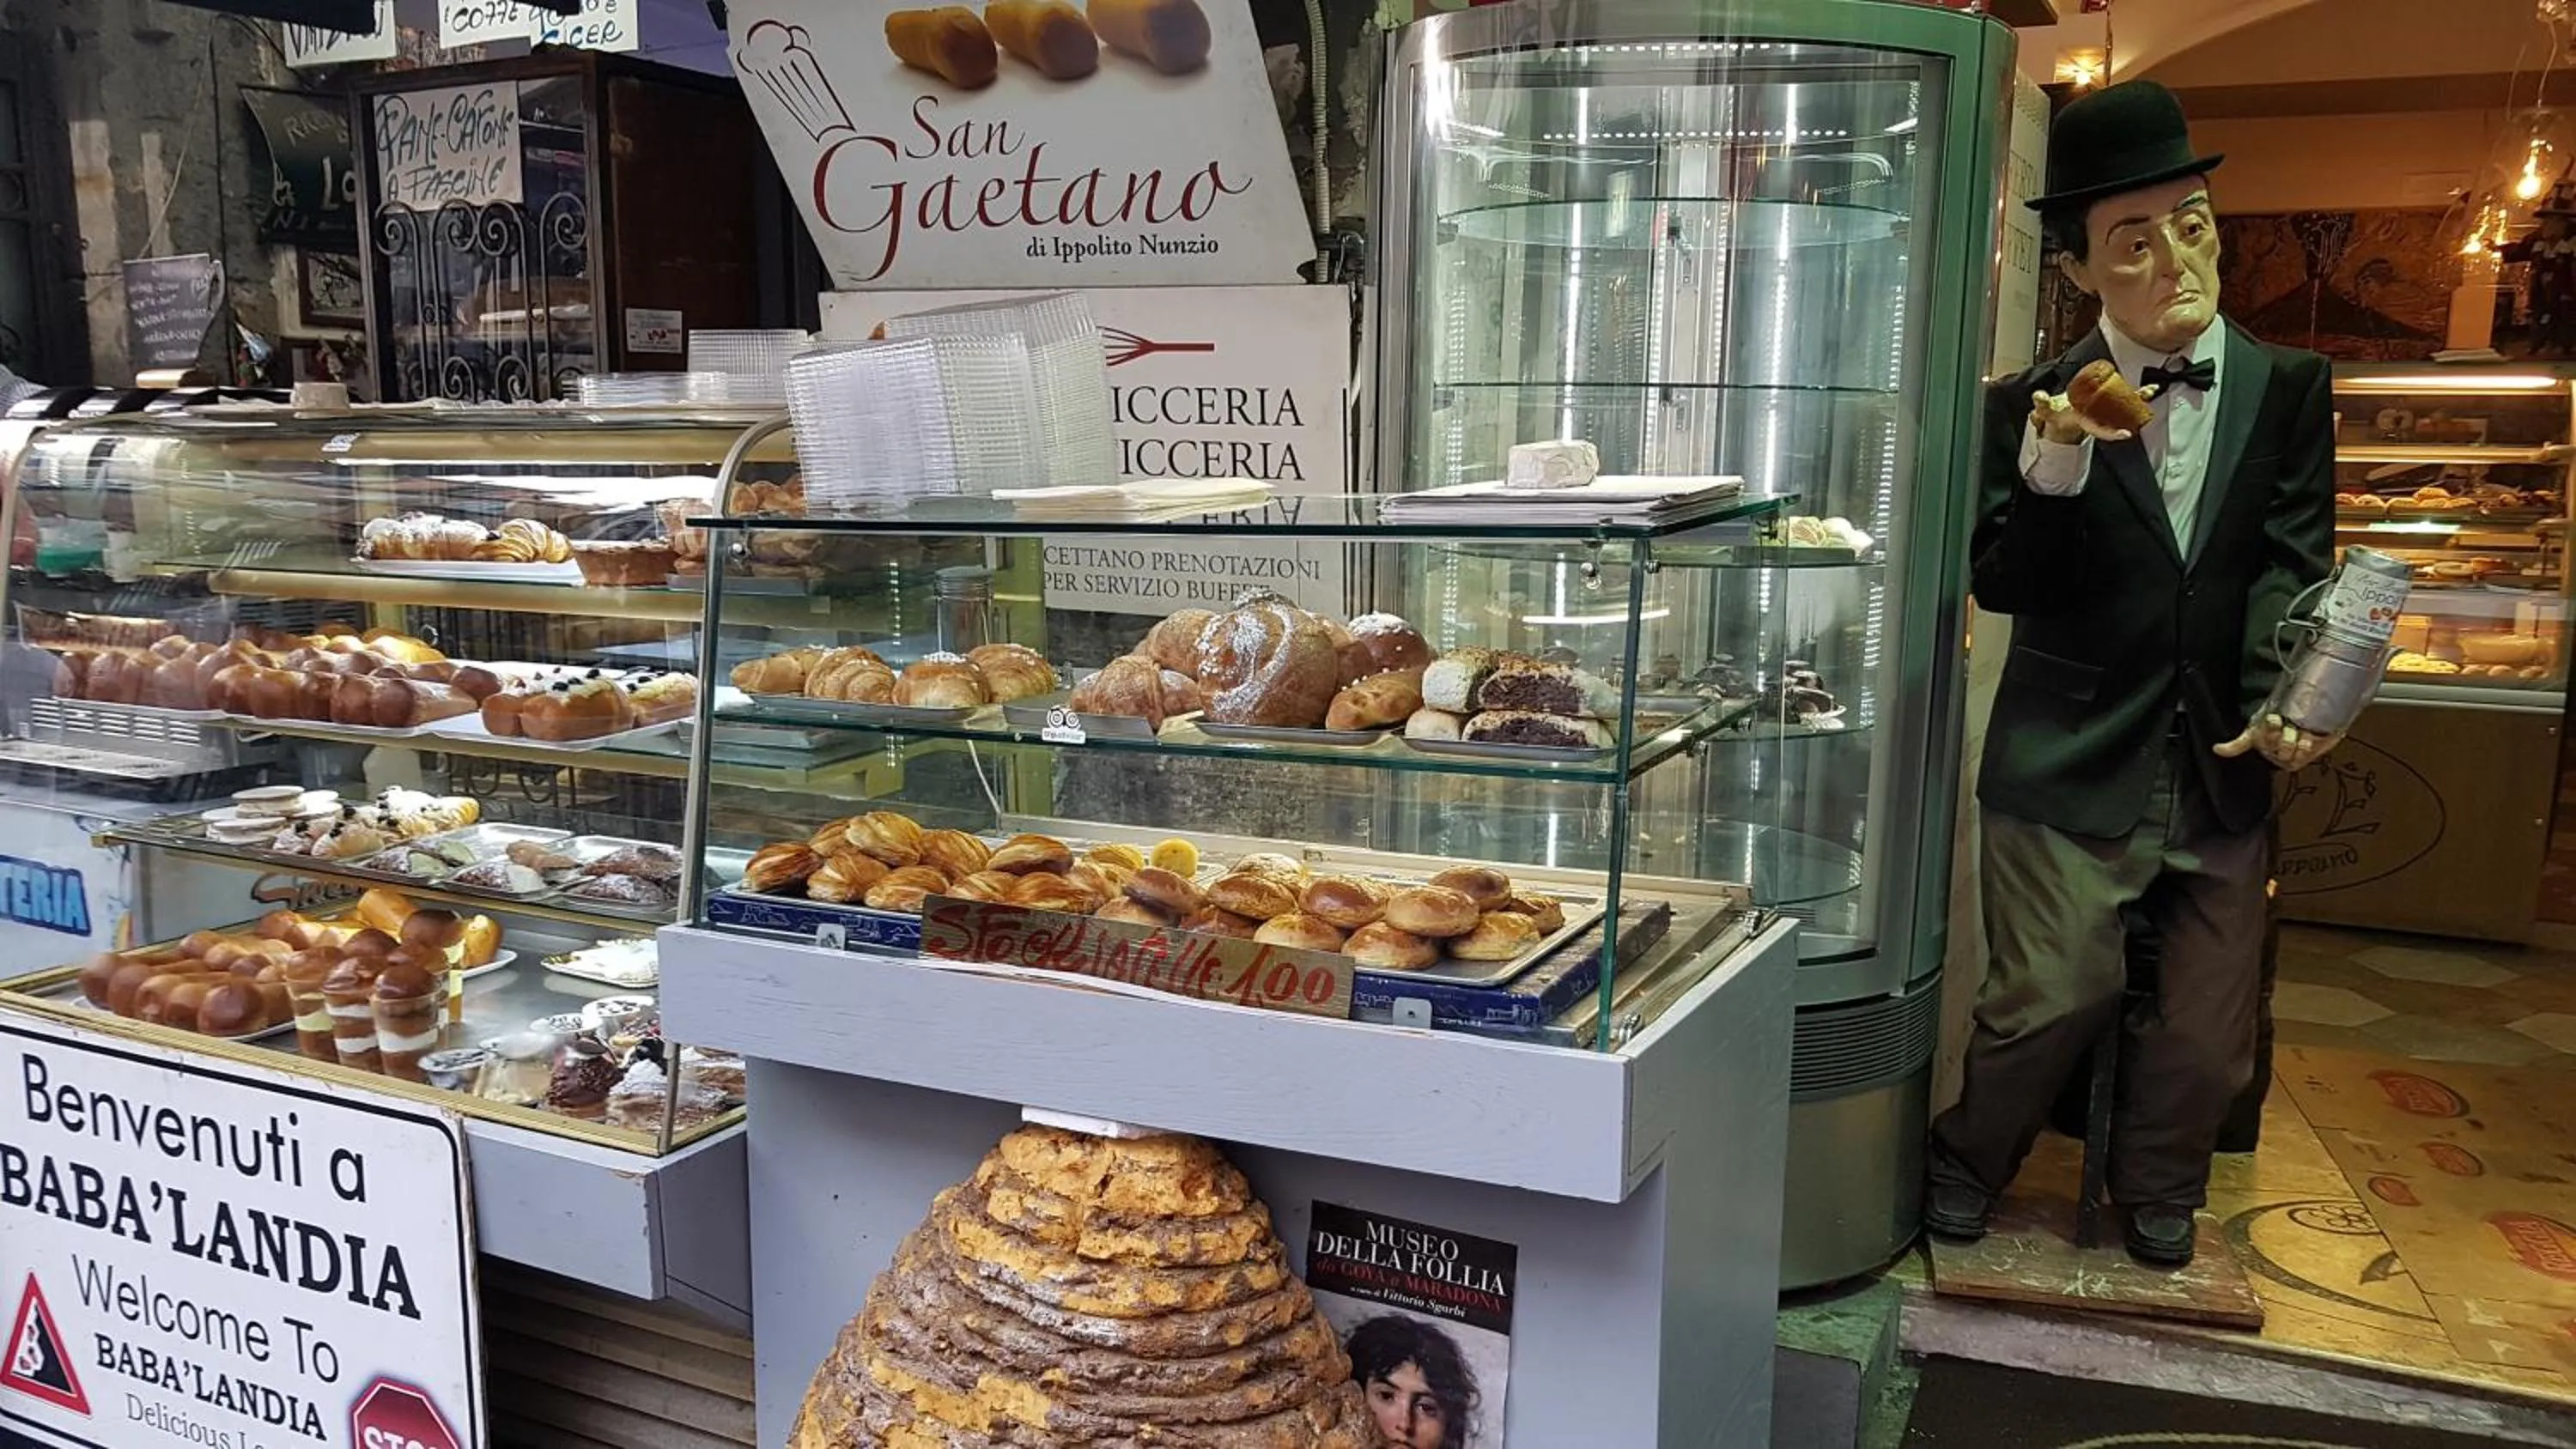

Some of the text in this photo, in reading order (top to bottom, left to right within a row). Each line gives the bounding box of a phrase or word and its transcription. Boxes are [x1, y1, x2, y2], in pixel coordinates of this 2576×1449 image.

[904, 95, 1025, 159] San
[813, 135, 1253, 282] Gaetano
[1026, 233, 1218, 263] di Ippolito Nunzio
[1113, 385, 1305, 427] ICCERIA
[1119, 438, 1305, 481] ICCERIA
[1043, 545, 1320, 580] CETTANO PRENOTAZIONI
[1043, 571, 1078, 591] PER
[1084, 573, 1180, 598] SERVIZIO
[22, 1053, 367, 1203] Benvenuti a
[0, 1143, 422, 1320] BABA'LANDIA
[1366, 1221, 1459, 1260] MUSEO
[1315, 1231, 1508, 1297] DELLA FOLLIA
[1340, 1261, 1385, 1283] GOYA
[1404, 1275, 1503, 1313] MARADONA
[72, 1253, 339, 1384] Welcome To
[1383, 1288, 1425, 1307] Vittorio
[94, 1332, 327, 1441] BABA'LANDIA
[125, 1392, 231, 1449] Delicious
